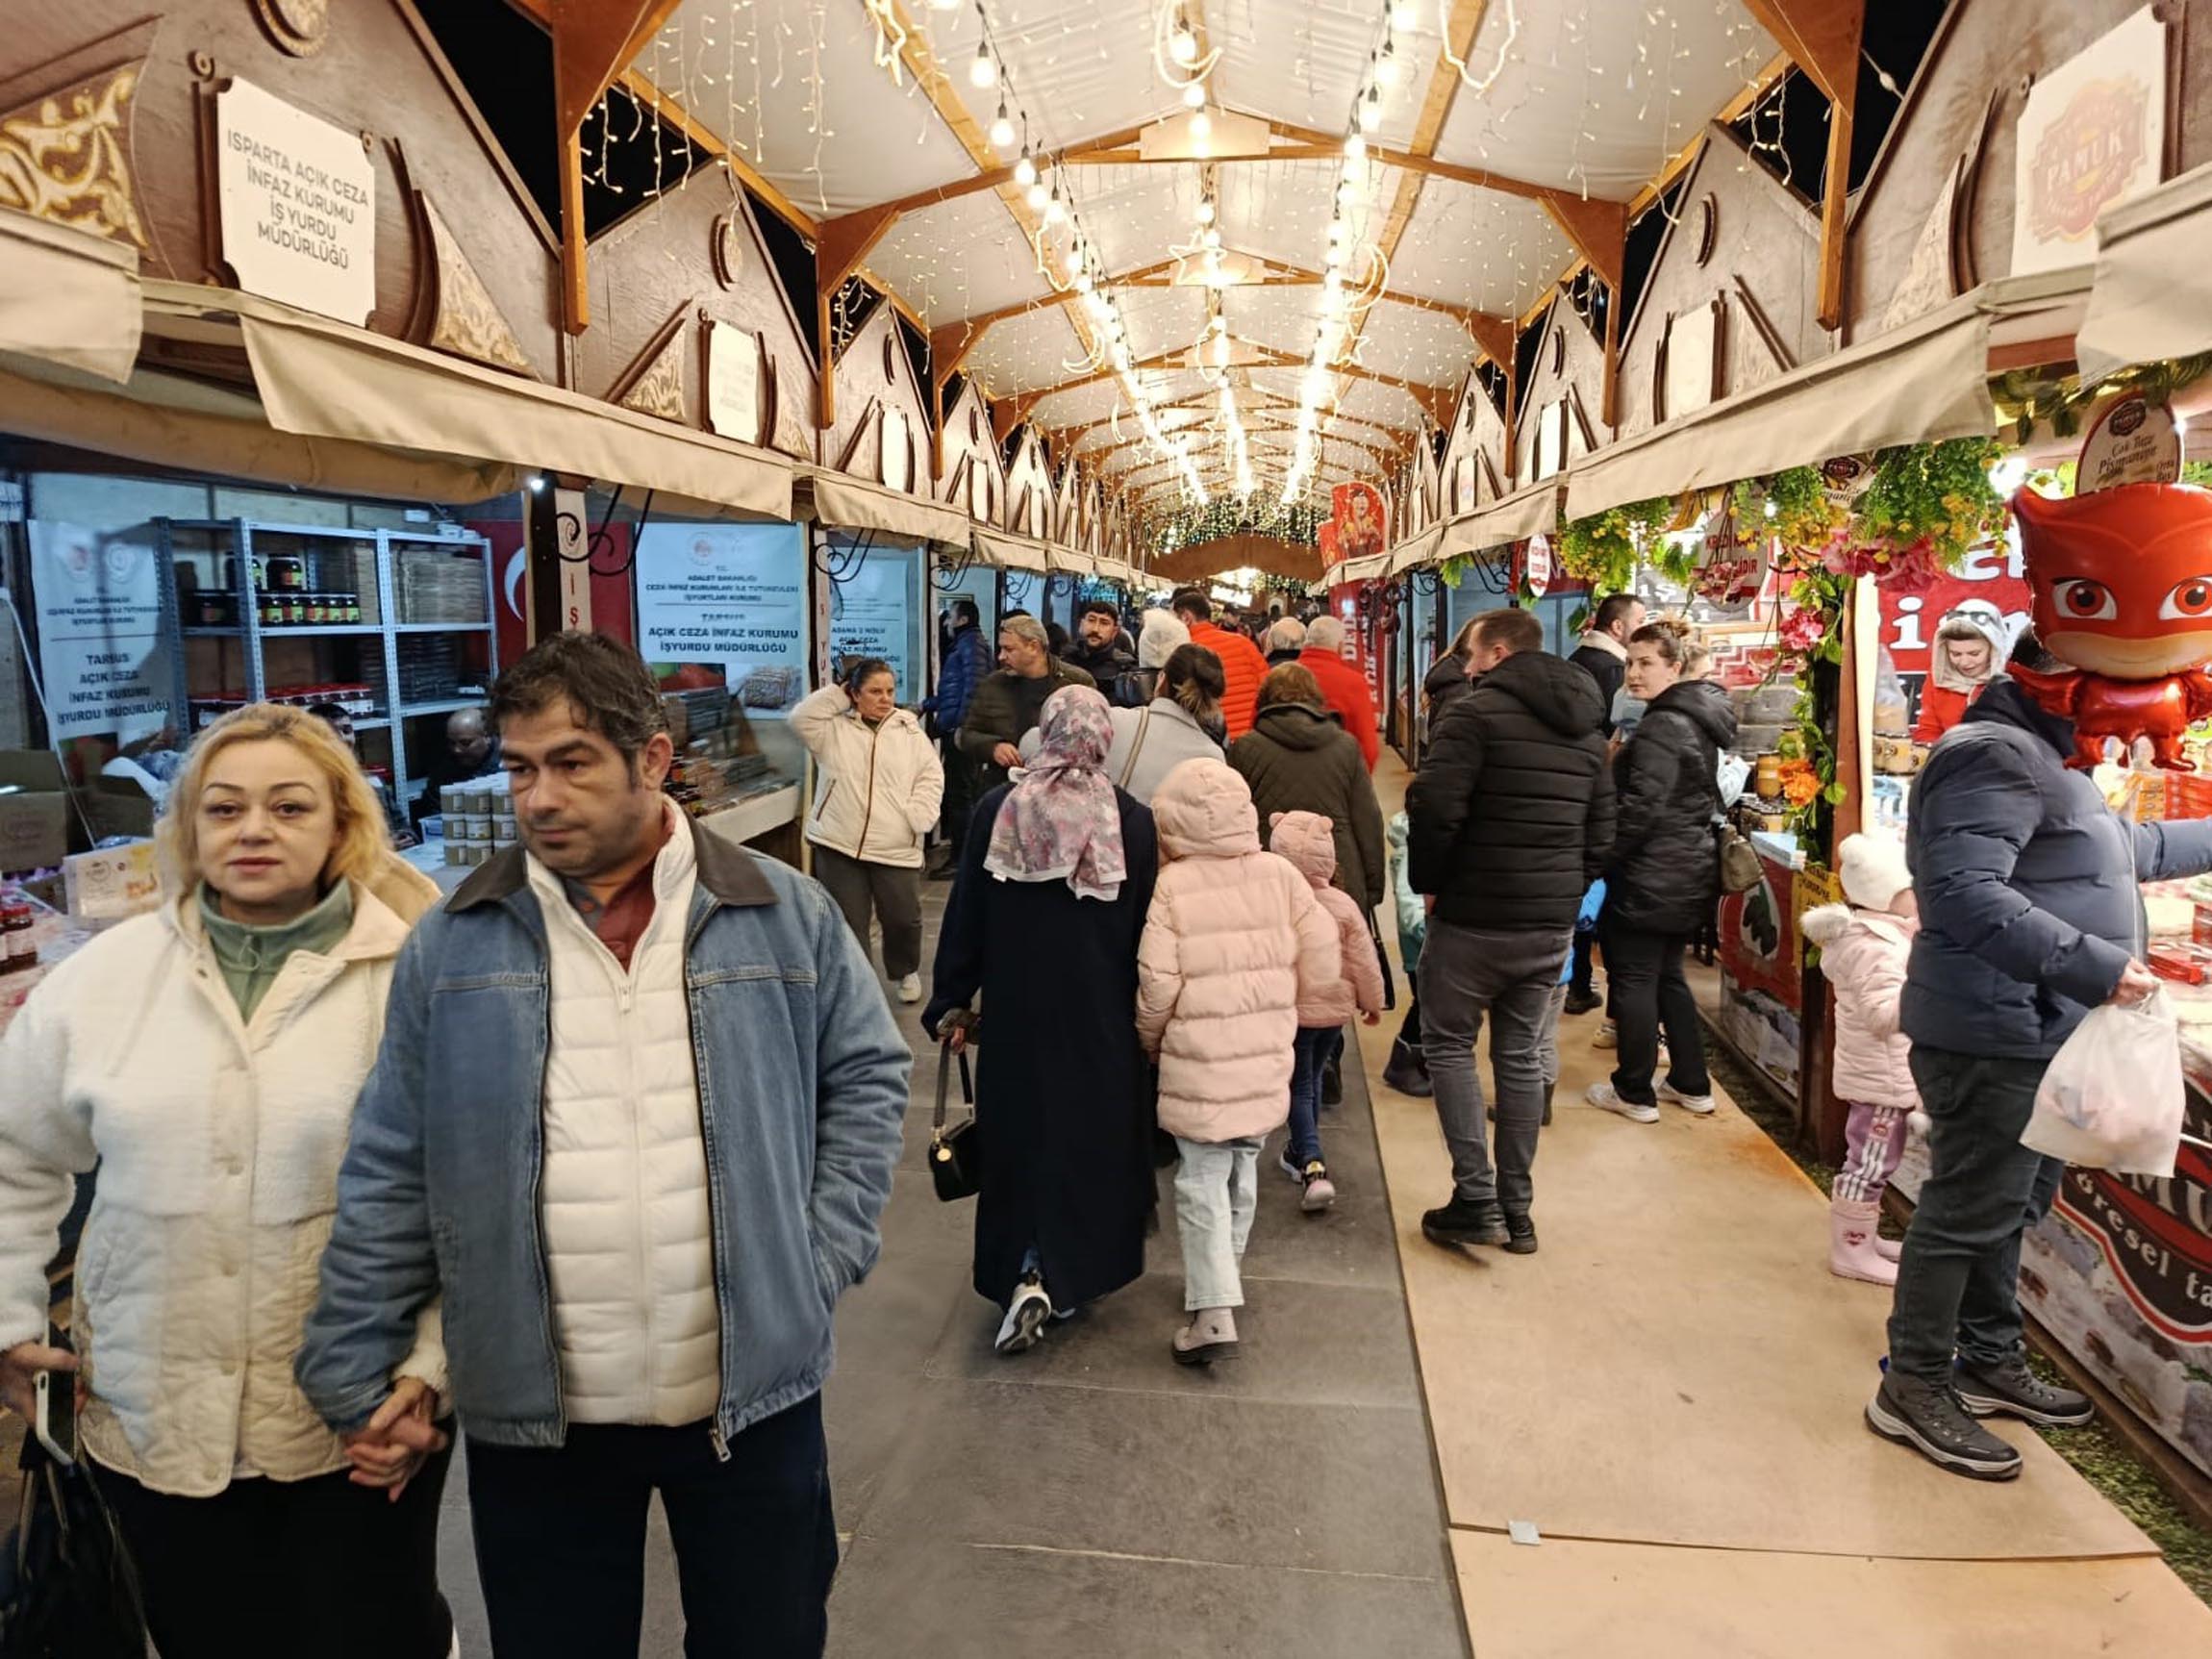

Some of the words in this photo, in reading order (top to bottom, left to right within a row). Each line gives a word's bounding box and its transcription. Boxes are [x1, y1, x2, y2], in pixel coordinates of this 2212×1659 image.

[227, 129, 290, 174] ISPARTA
[294, 161, 329, 190] AÇIK
[332, 178, 369, 207] CEZA
[246, 159, 291, 198] İNFAZ
[294, 186, 355, 224] KURUMU
[270, 194, 285, 226] İŞ
[288, 207, 337, 240] YURDU
[257, 220, 348, 269] MÜDÜRLÜĞÜ
[648, 628, 676, 639] AÇIK
[679, 628, 710, 638] CEZA
[712, 626, 745, 638] İNFAZ
[747, 629, 799, 640] KURUMU
[660, 641, 711, 654] İŞYURDU
[715, 641, 787, 654] MÜDÜRLÜĞÜ
[79, 671, 109, 686] AÇIK
[68, 689, 104, 704] İNFAZ
